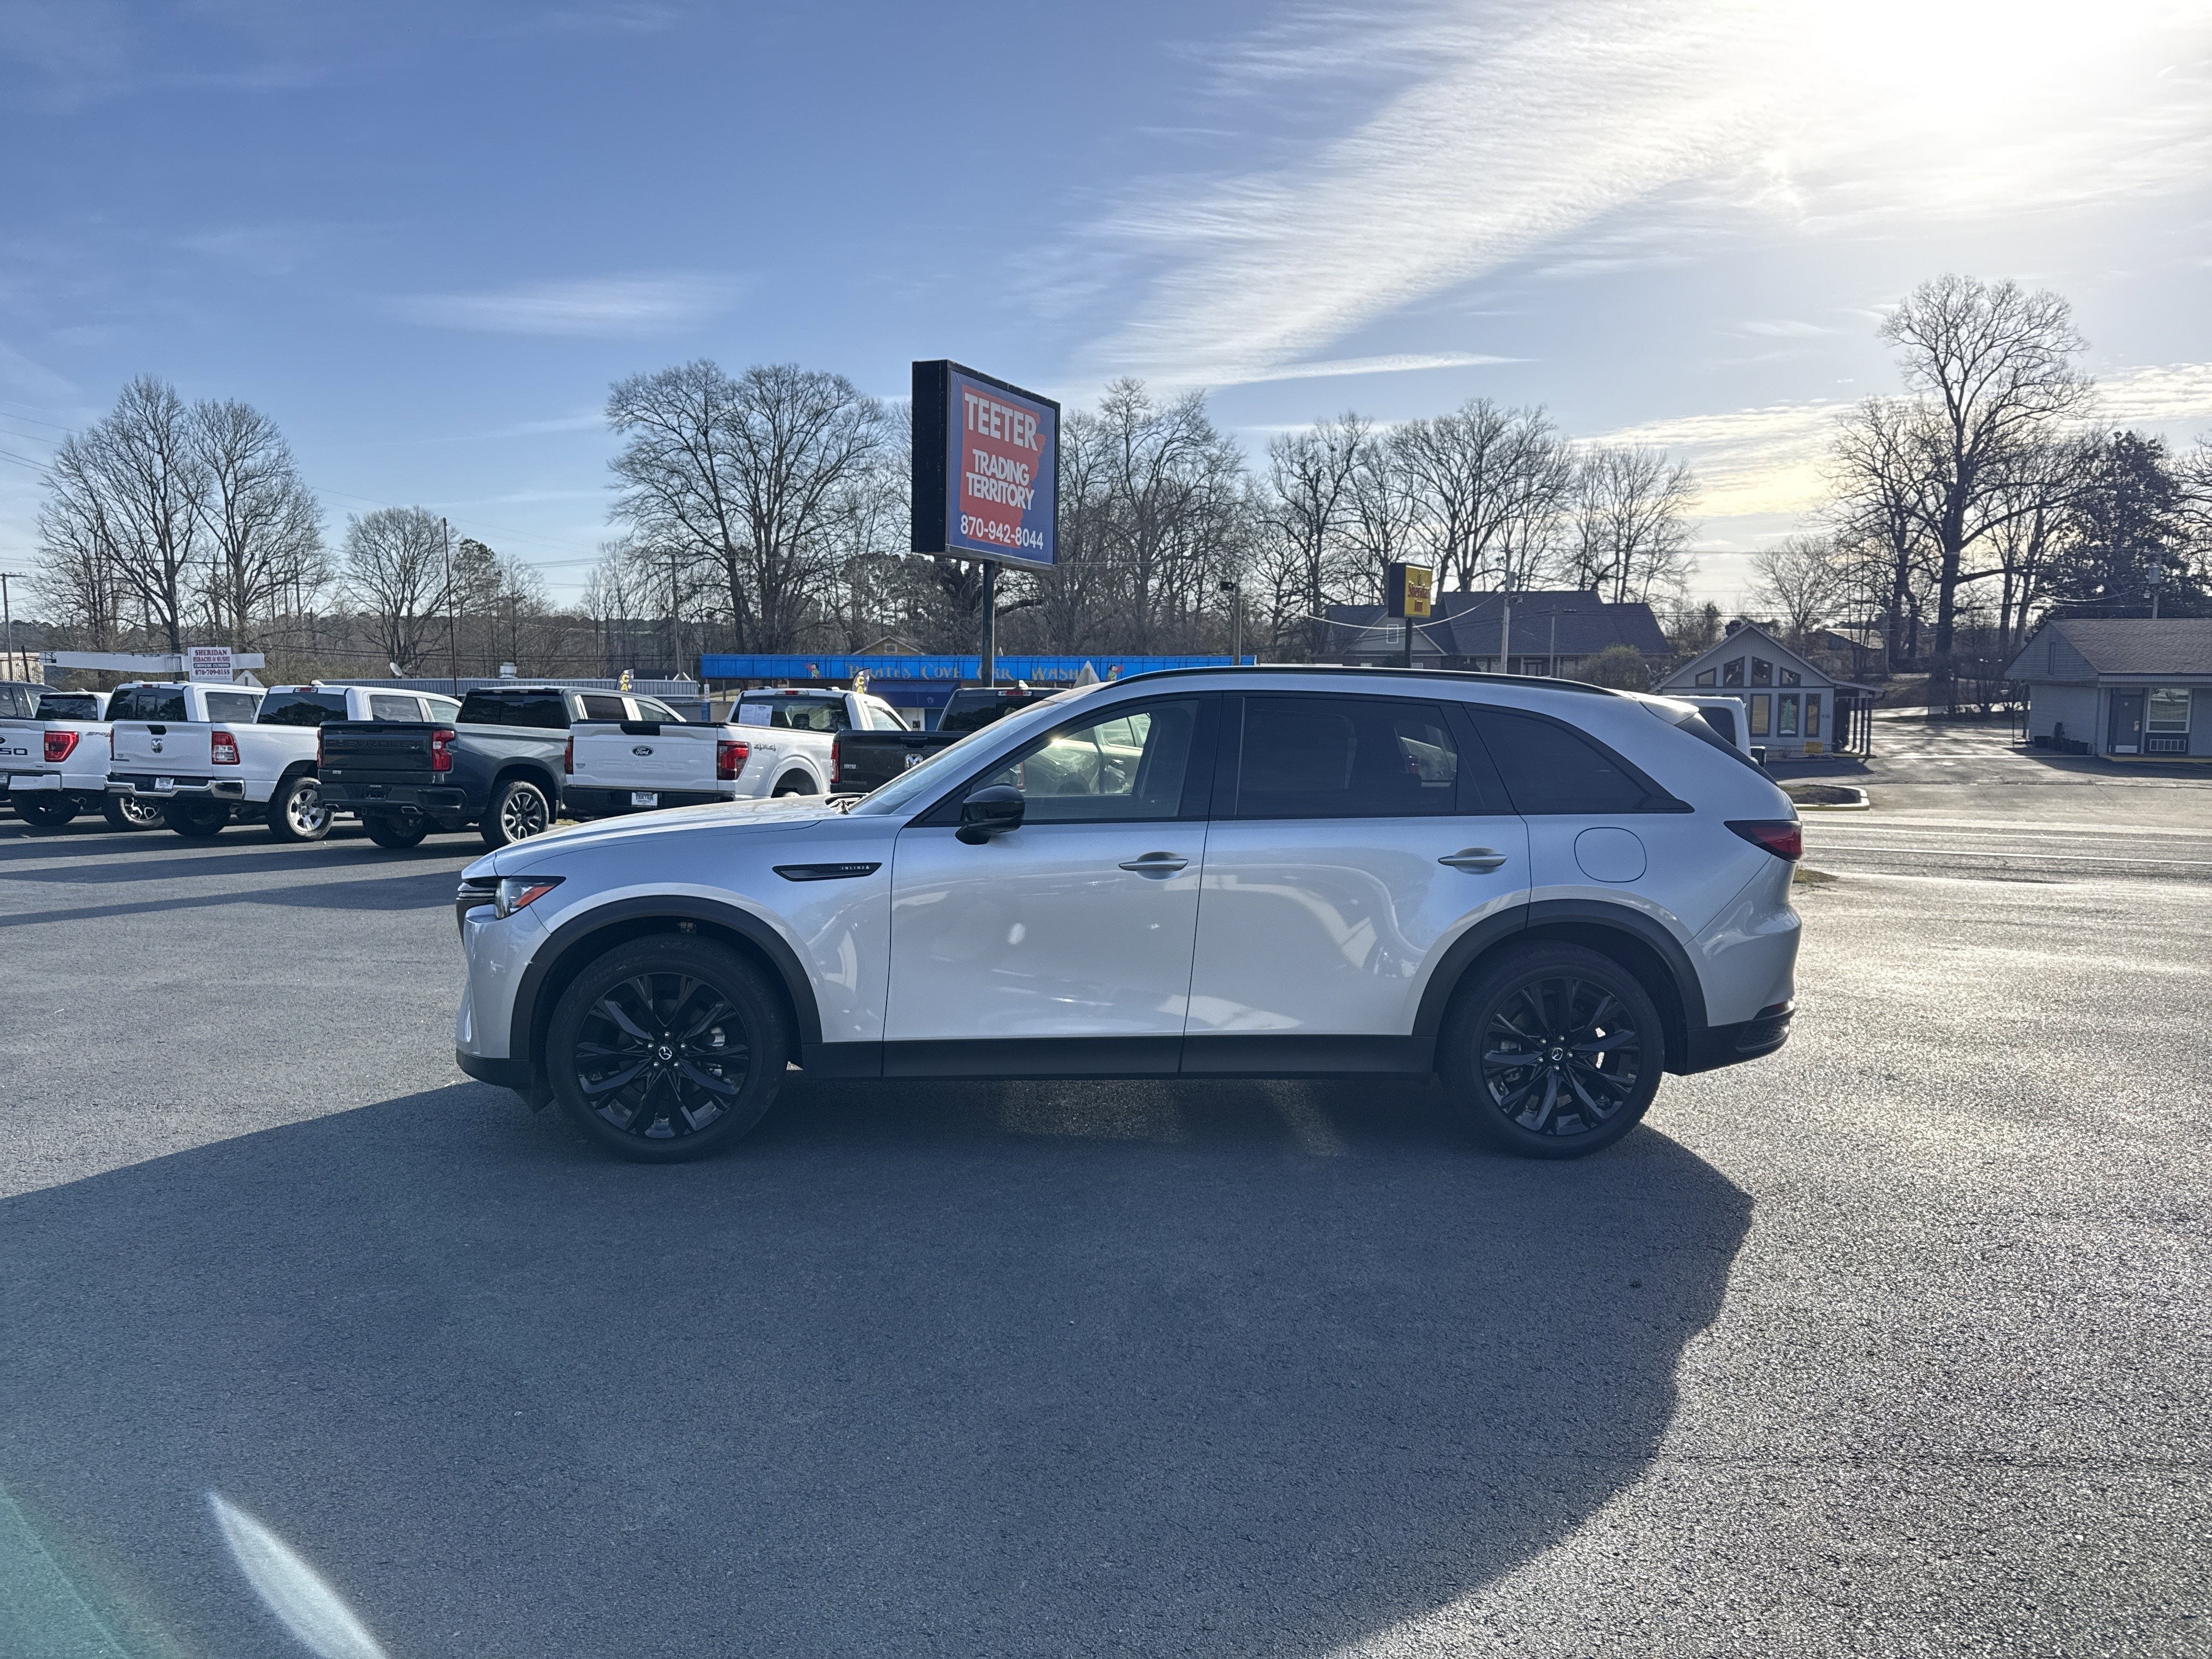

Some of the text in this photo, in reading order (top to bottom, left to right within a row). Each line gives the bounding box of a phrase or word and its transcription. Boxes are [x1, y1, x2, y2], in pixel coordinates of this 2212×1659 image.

[964, 392, 1037, 452] TEETER
[973, 448, 1030, 486] TRADING
[966, 471, 1035, 511] TERRITORY
[960, 514, 1043, 550] 870-942-8044
[1031, 667, 1079, 680] WASH
[325, 740, 422, 749] CHEVROLET
